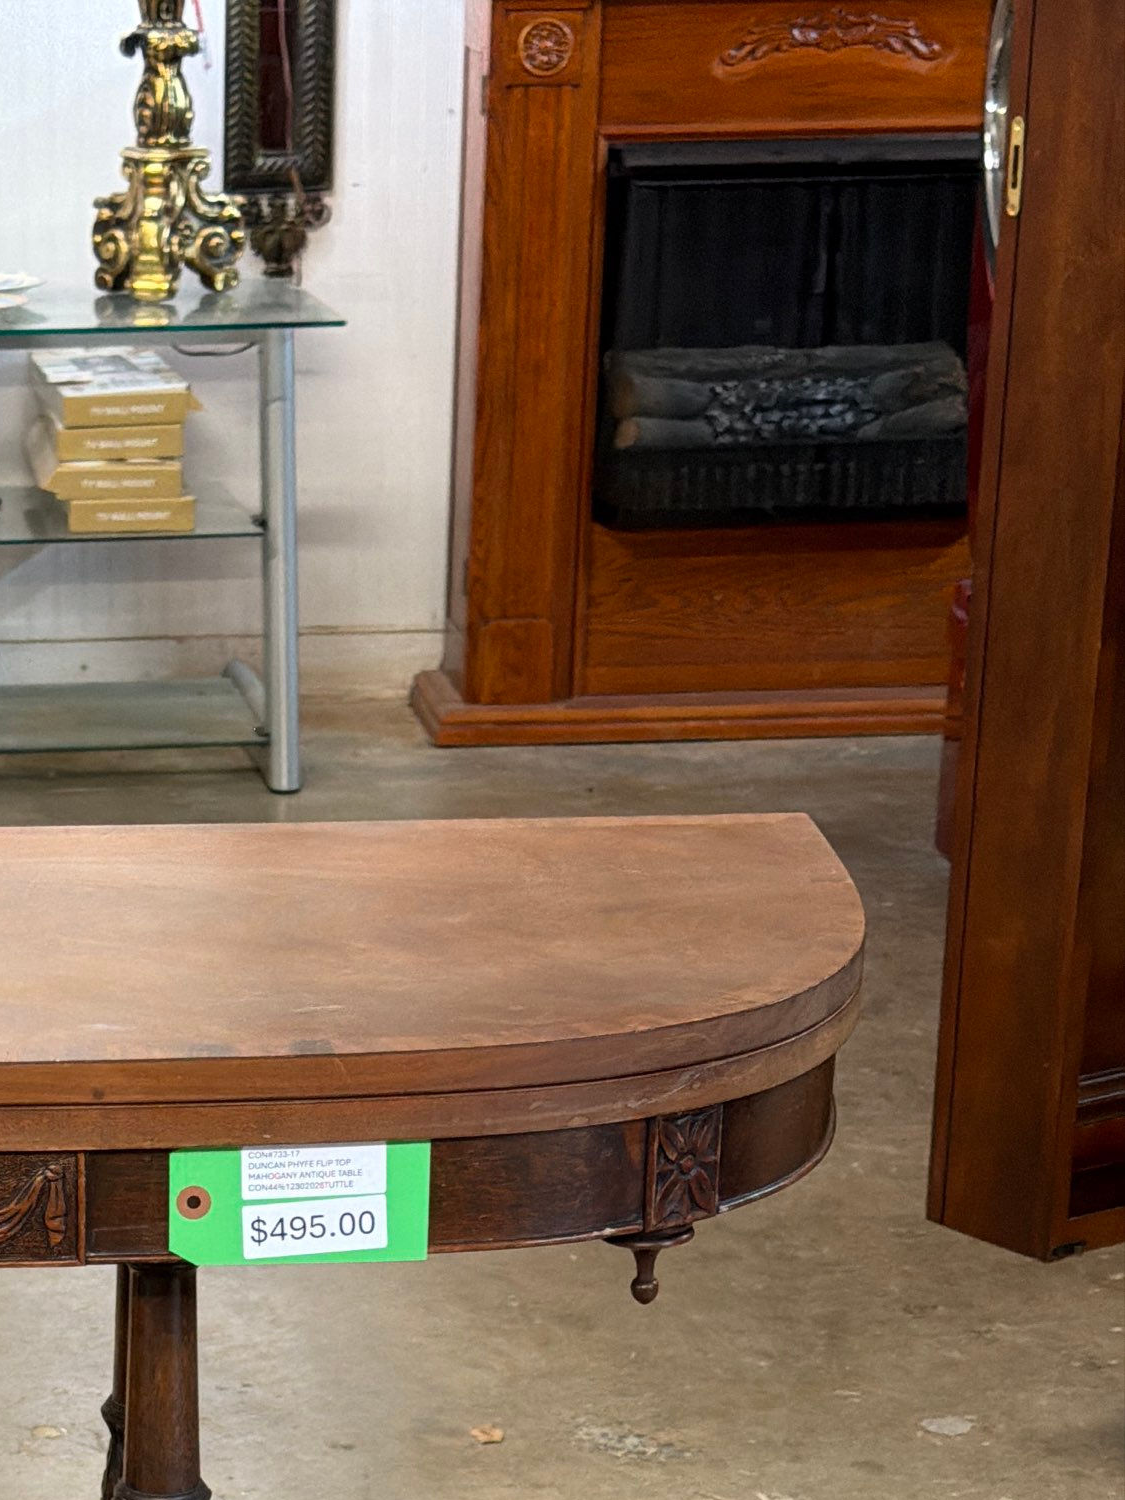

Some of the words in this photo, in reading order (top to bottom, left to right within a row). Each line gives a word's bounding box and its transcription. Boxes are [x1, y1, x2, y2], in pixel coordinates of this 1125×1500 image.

[248, 1150, 300, 1159] CON#733-17
[248, 1162, 286, 1170] DUNCAN
[288, 1160, 314, 1168] PHYFE
[316, 1160, 333, 1168] FLIP
[248, 1172, 296, 1180] MAHOGANY
[299, 1170, 336, 1179] ANTIQUE
[338, 1169, 362, 1177] TABLE
[250, 1210, 376, 1246] $495.00
